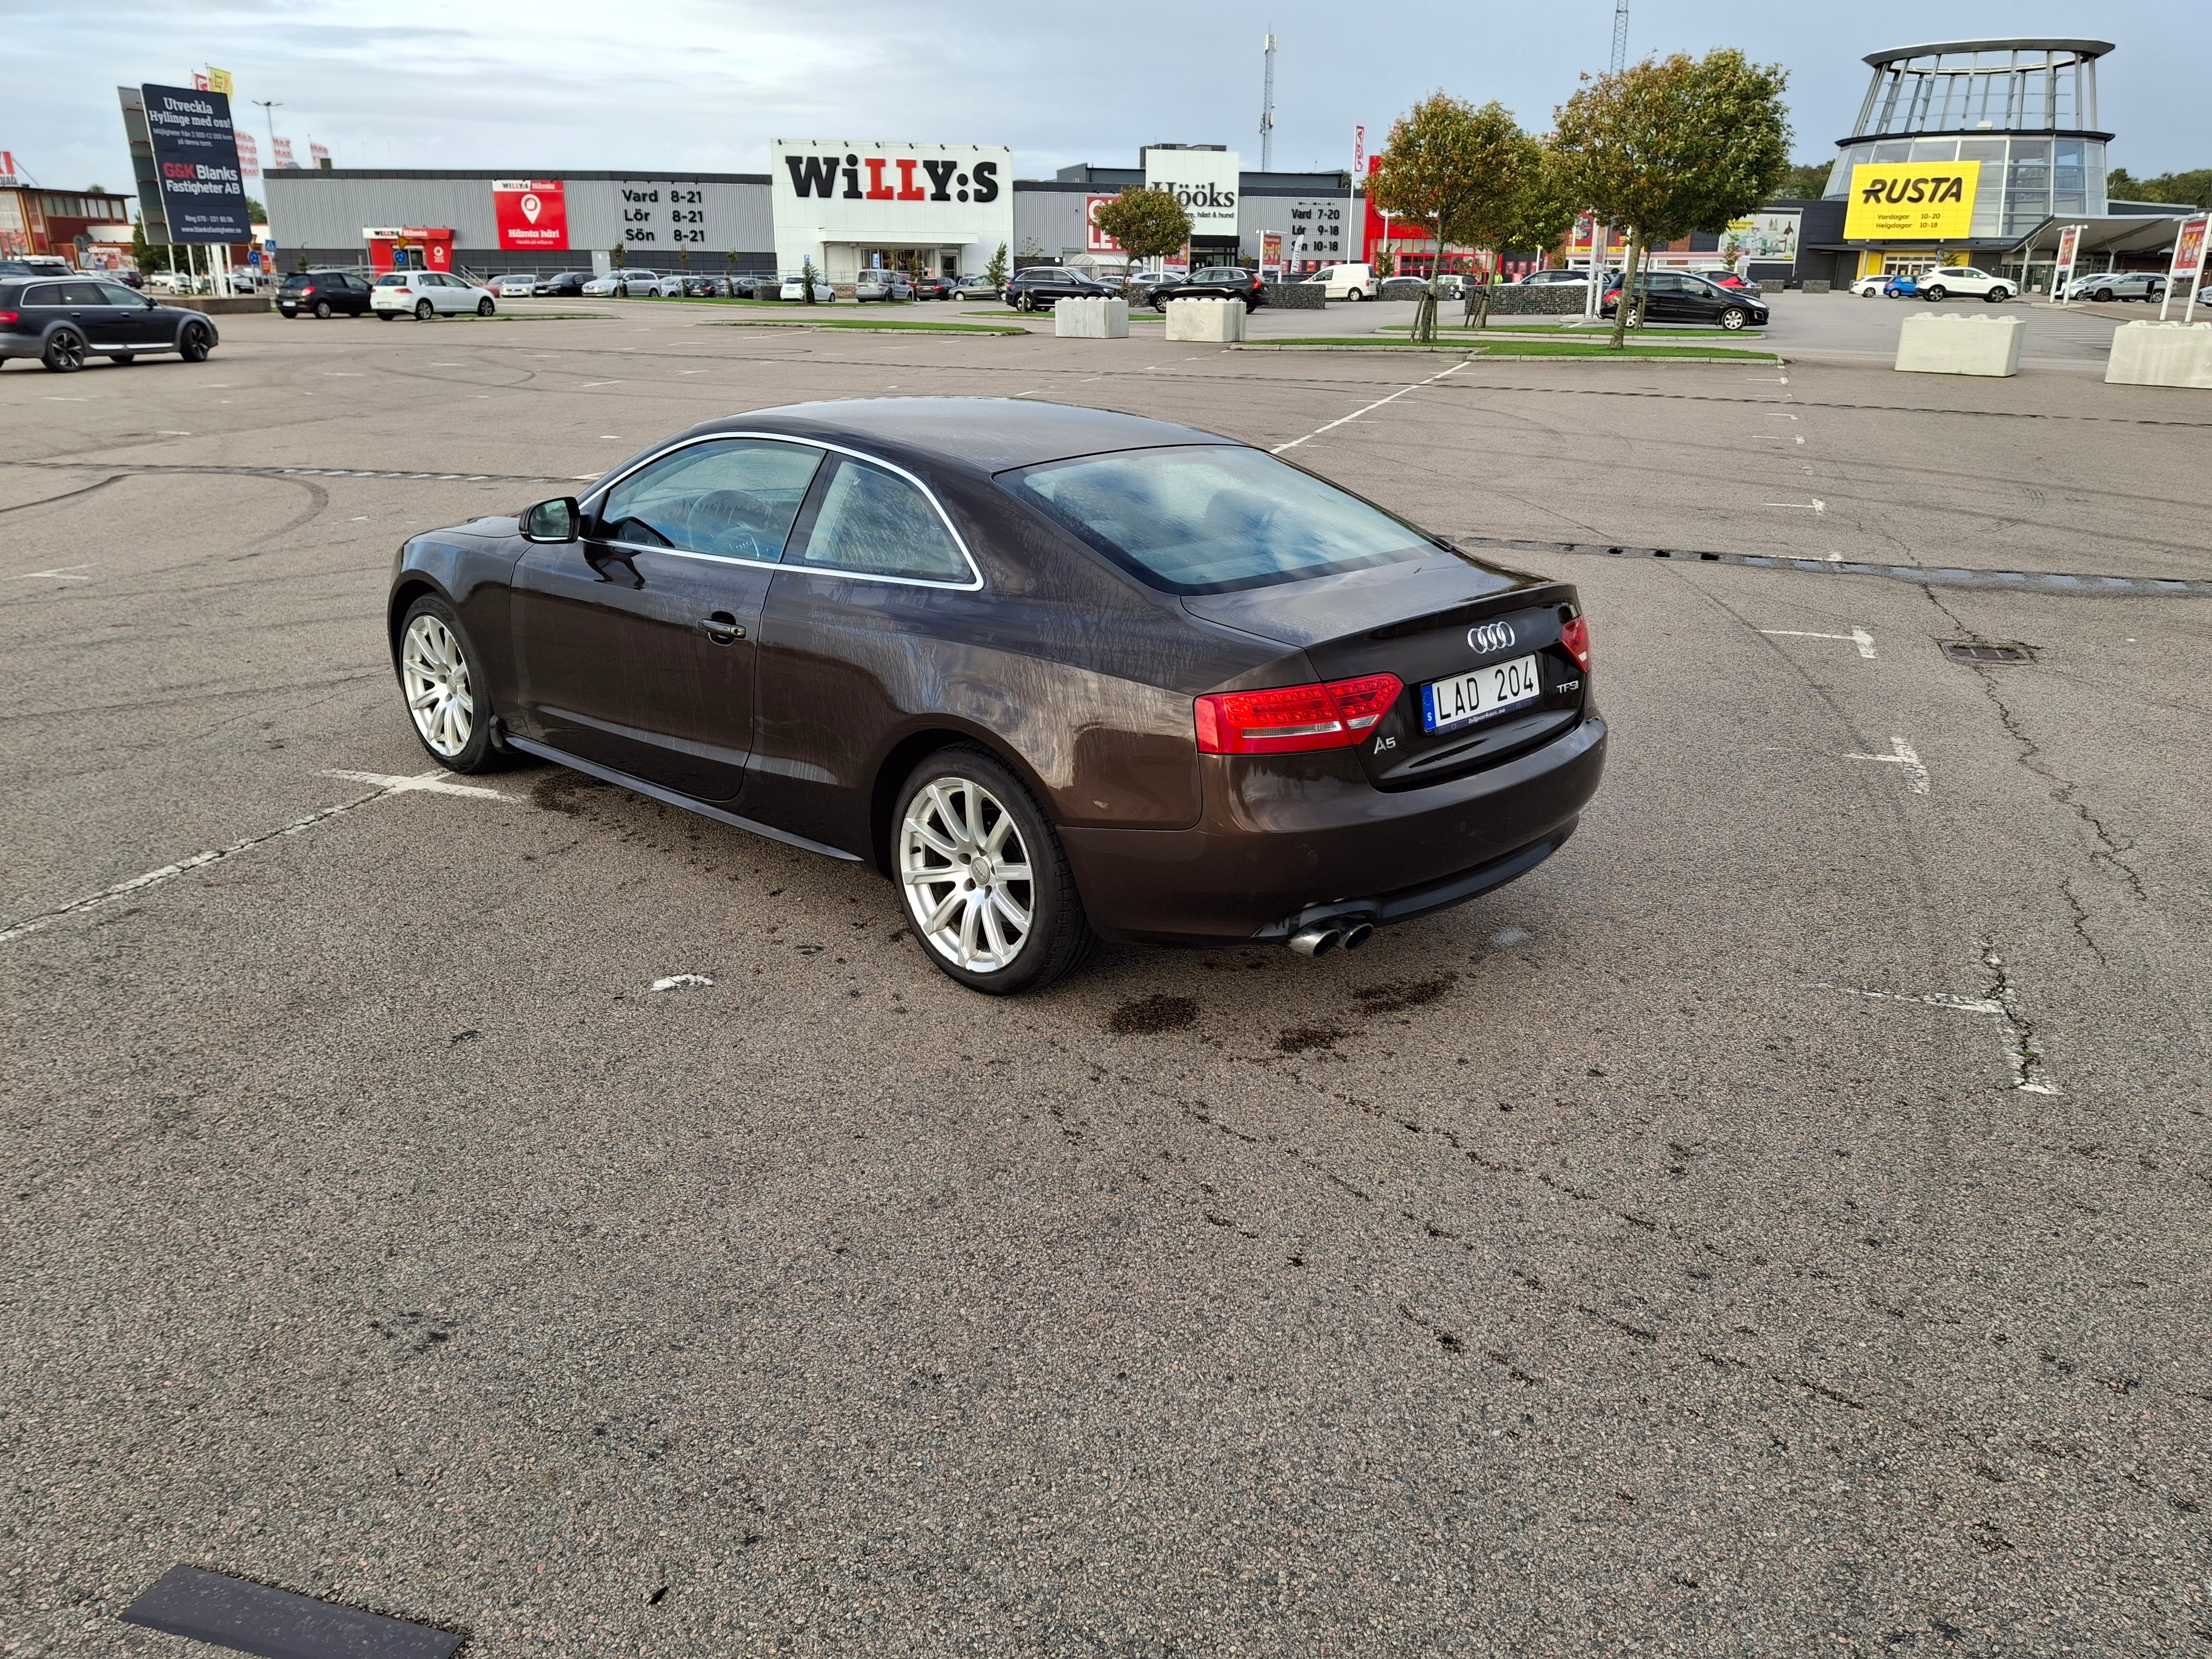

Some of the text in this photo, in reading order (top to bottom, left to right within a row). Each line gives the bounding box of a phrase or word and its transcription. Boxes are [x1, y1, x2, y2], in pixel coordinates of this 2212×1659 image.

[163, 97, 214, 115] Utveckla
[149, 110, 232, 128] Hyllinge med oss!
[163, 163, 239, 181] G&K Blanks
[165, 179, 240, 196] Fastigheter AB
[1862, 177, 1962, 204] RUSTA
[622, 190, 702, 203] Vard 8-21
[625, 209, 703, 223] Lör 8-21
[1291, 209, 1340, 220] Vard 7-20
[508, 228, 560, 237] Hämta här!
[626, 228, 704, 242] Sön 8-21
[1293, 225, 1339, 235] Lör 9-18
[1291, 241, 1338, 251] Sn 10-18
[1437, 661, 1533, 720] LAD 204
[1557, 680, 1579, 694] TFSI
[1427, 712, 1432, 722] S
[1468, 707, 1506, 724] bilparken.se
[1373, 736, 1396, 754] A5
